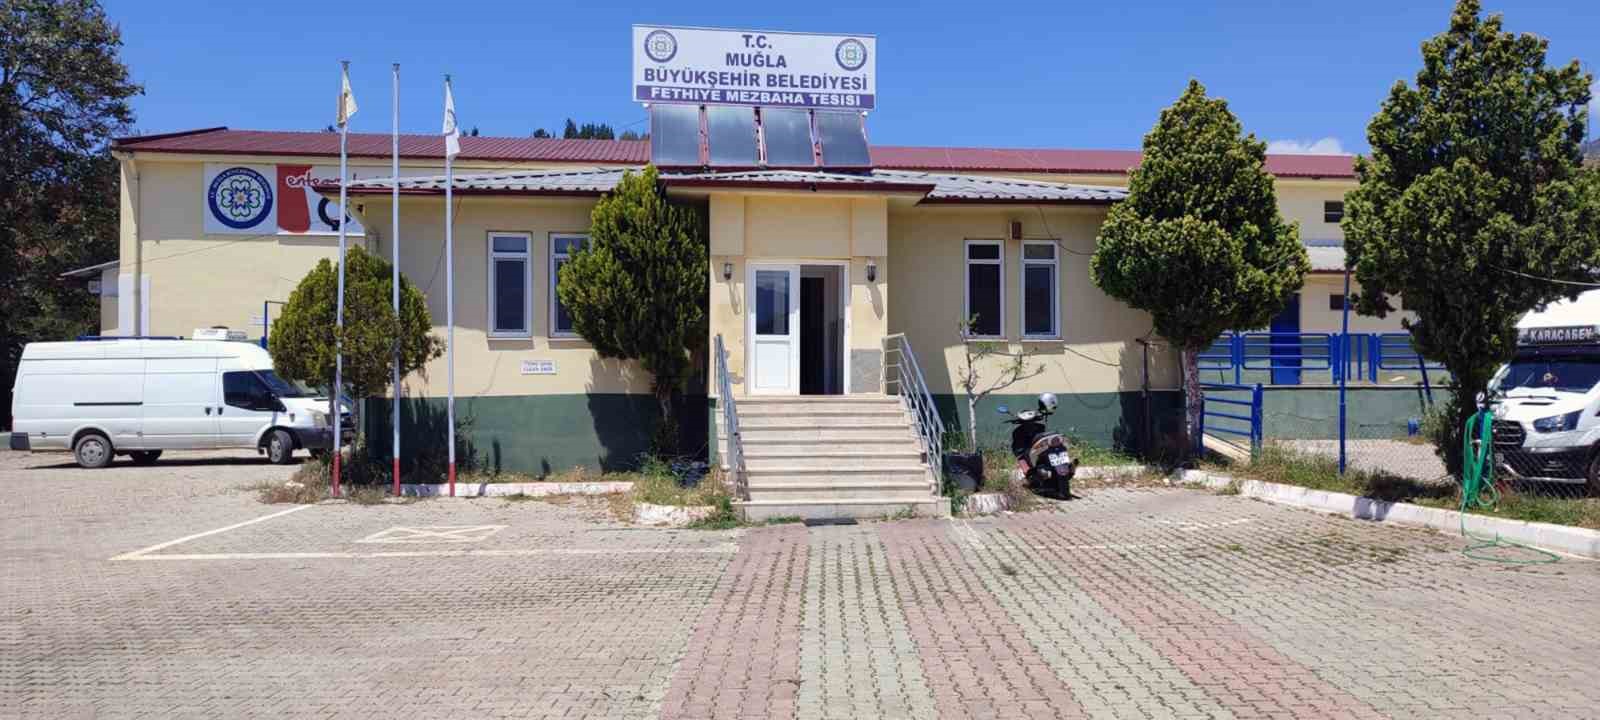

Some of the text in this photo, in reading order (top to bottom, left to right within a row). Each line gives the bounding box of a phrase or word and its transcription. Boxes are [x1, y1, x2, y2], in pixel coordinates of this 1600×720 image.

[742, 34, 772, 49] T.C.
[726, 51, 787, 68] MUĞLA
[644, 66, 867, 91] BÜYÜKŞEHİR BELEDİYESİ
[726, 90, 805, 104] MEZBAHA
